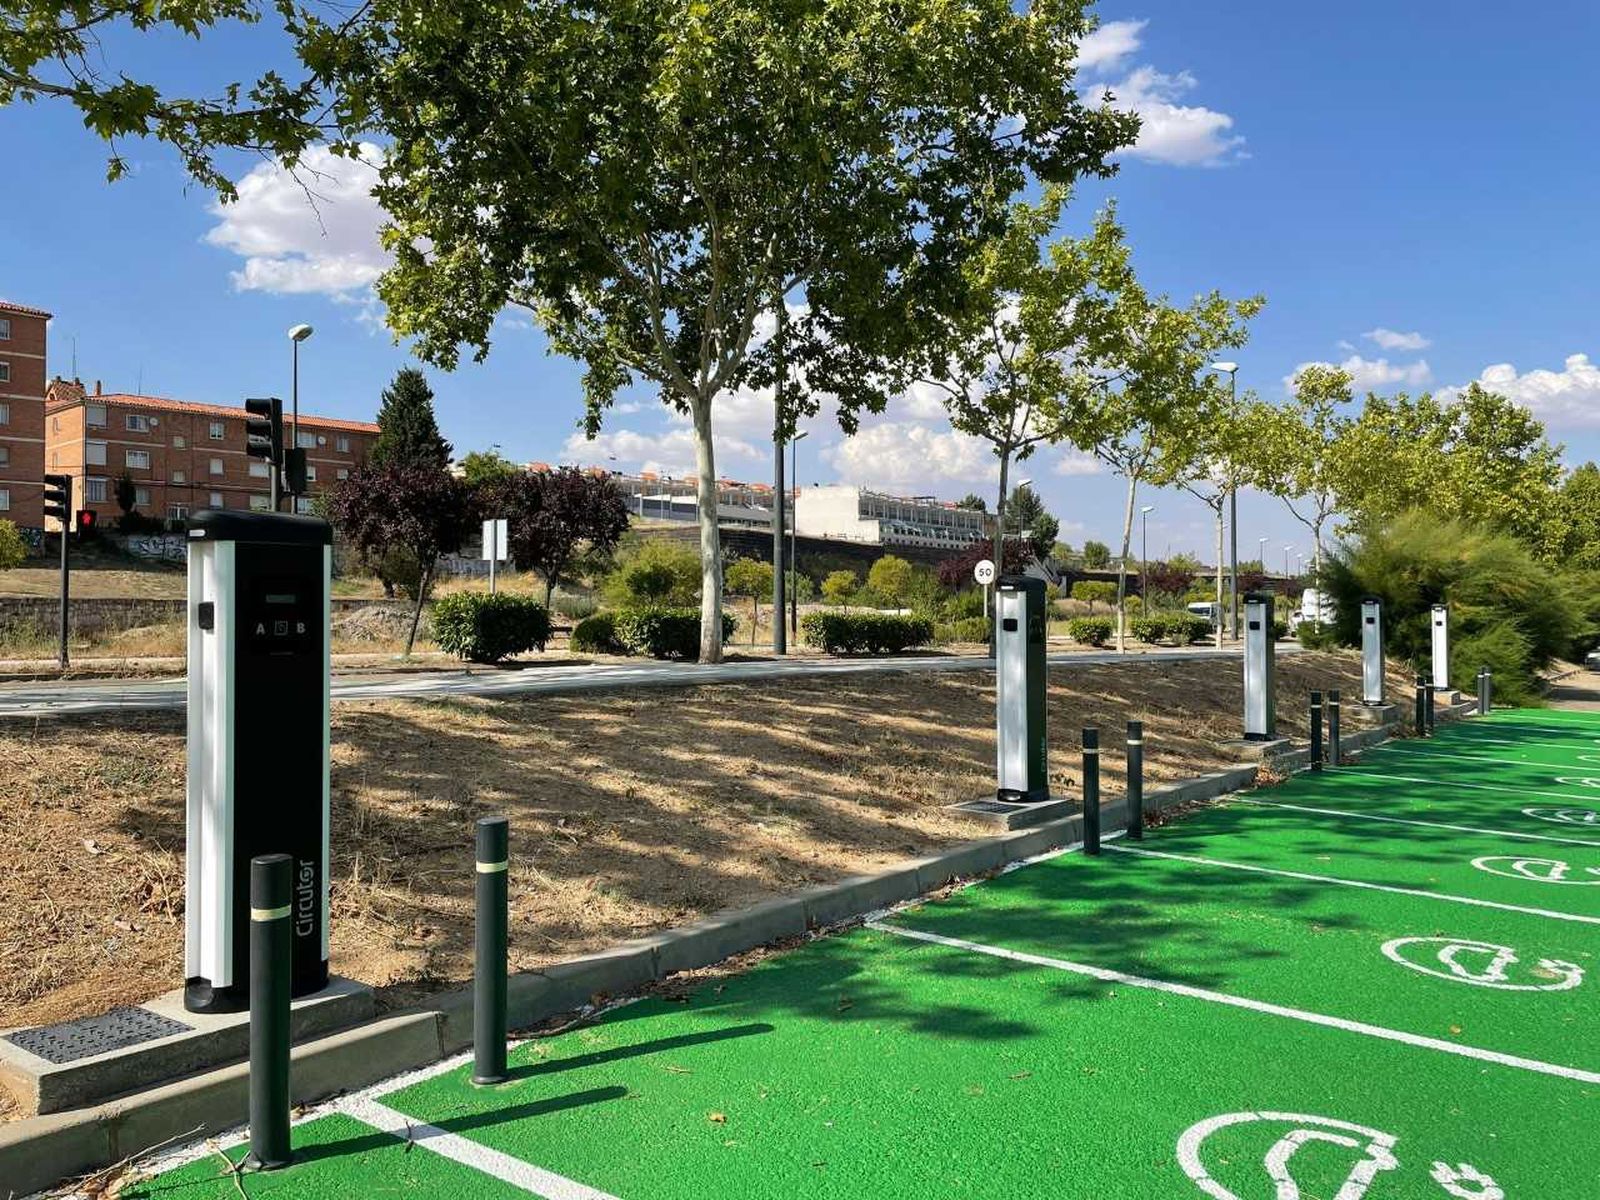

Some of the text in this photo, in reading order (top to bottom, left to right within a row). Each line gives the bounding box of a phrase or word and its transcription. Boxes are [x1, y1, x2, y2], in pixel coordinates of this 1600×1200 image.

[979, 568, 992, 577] 50
[256, 622, 306, 635] A B
